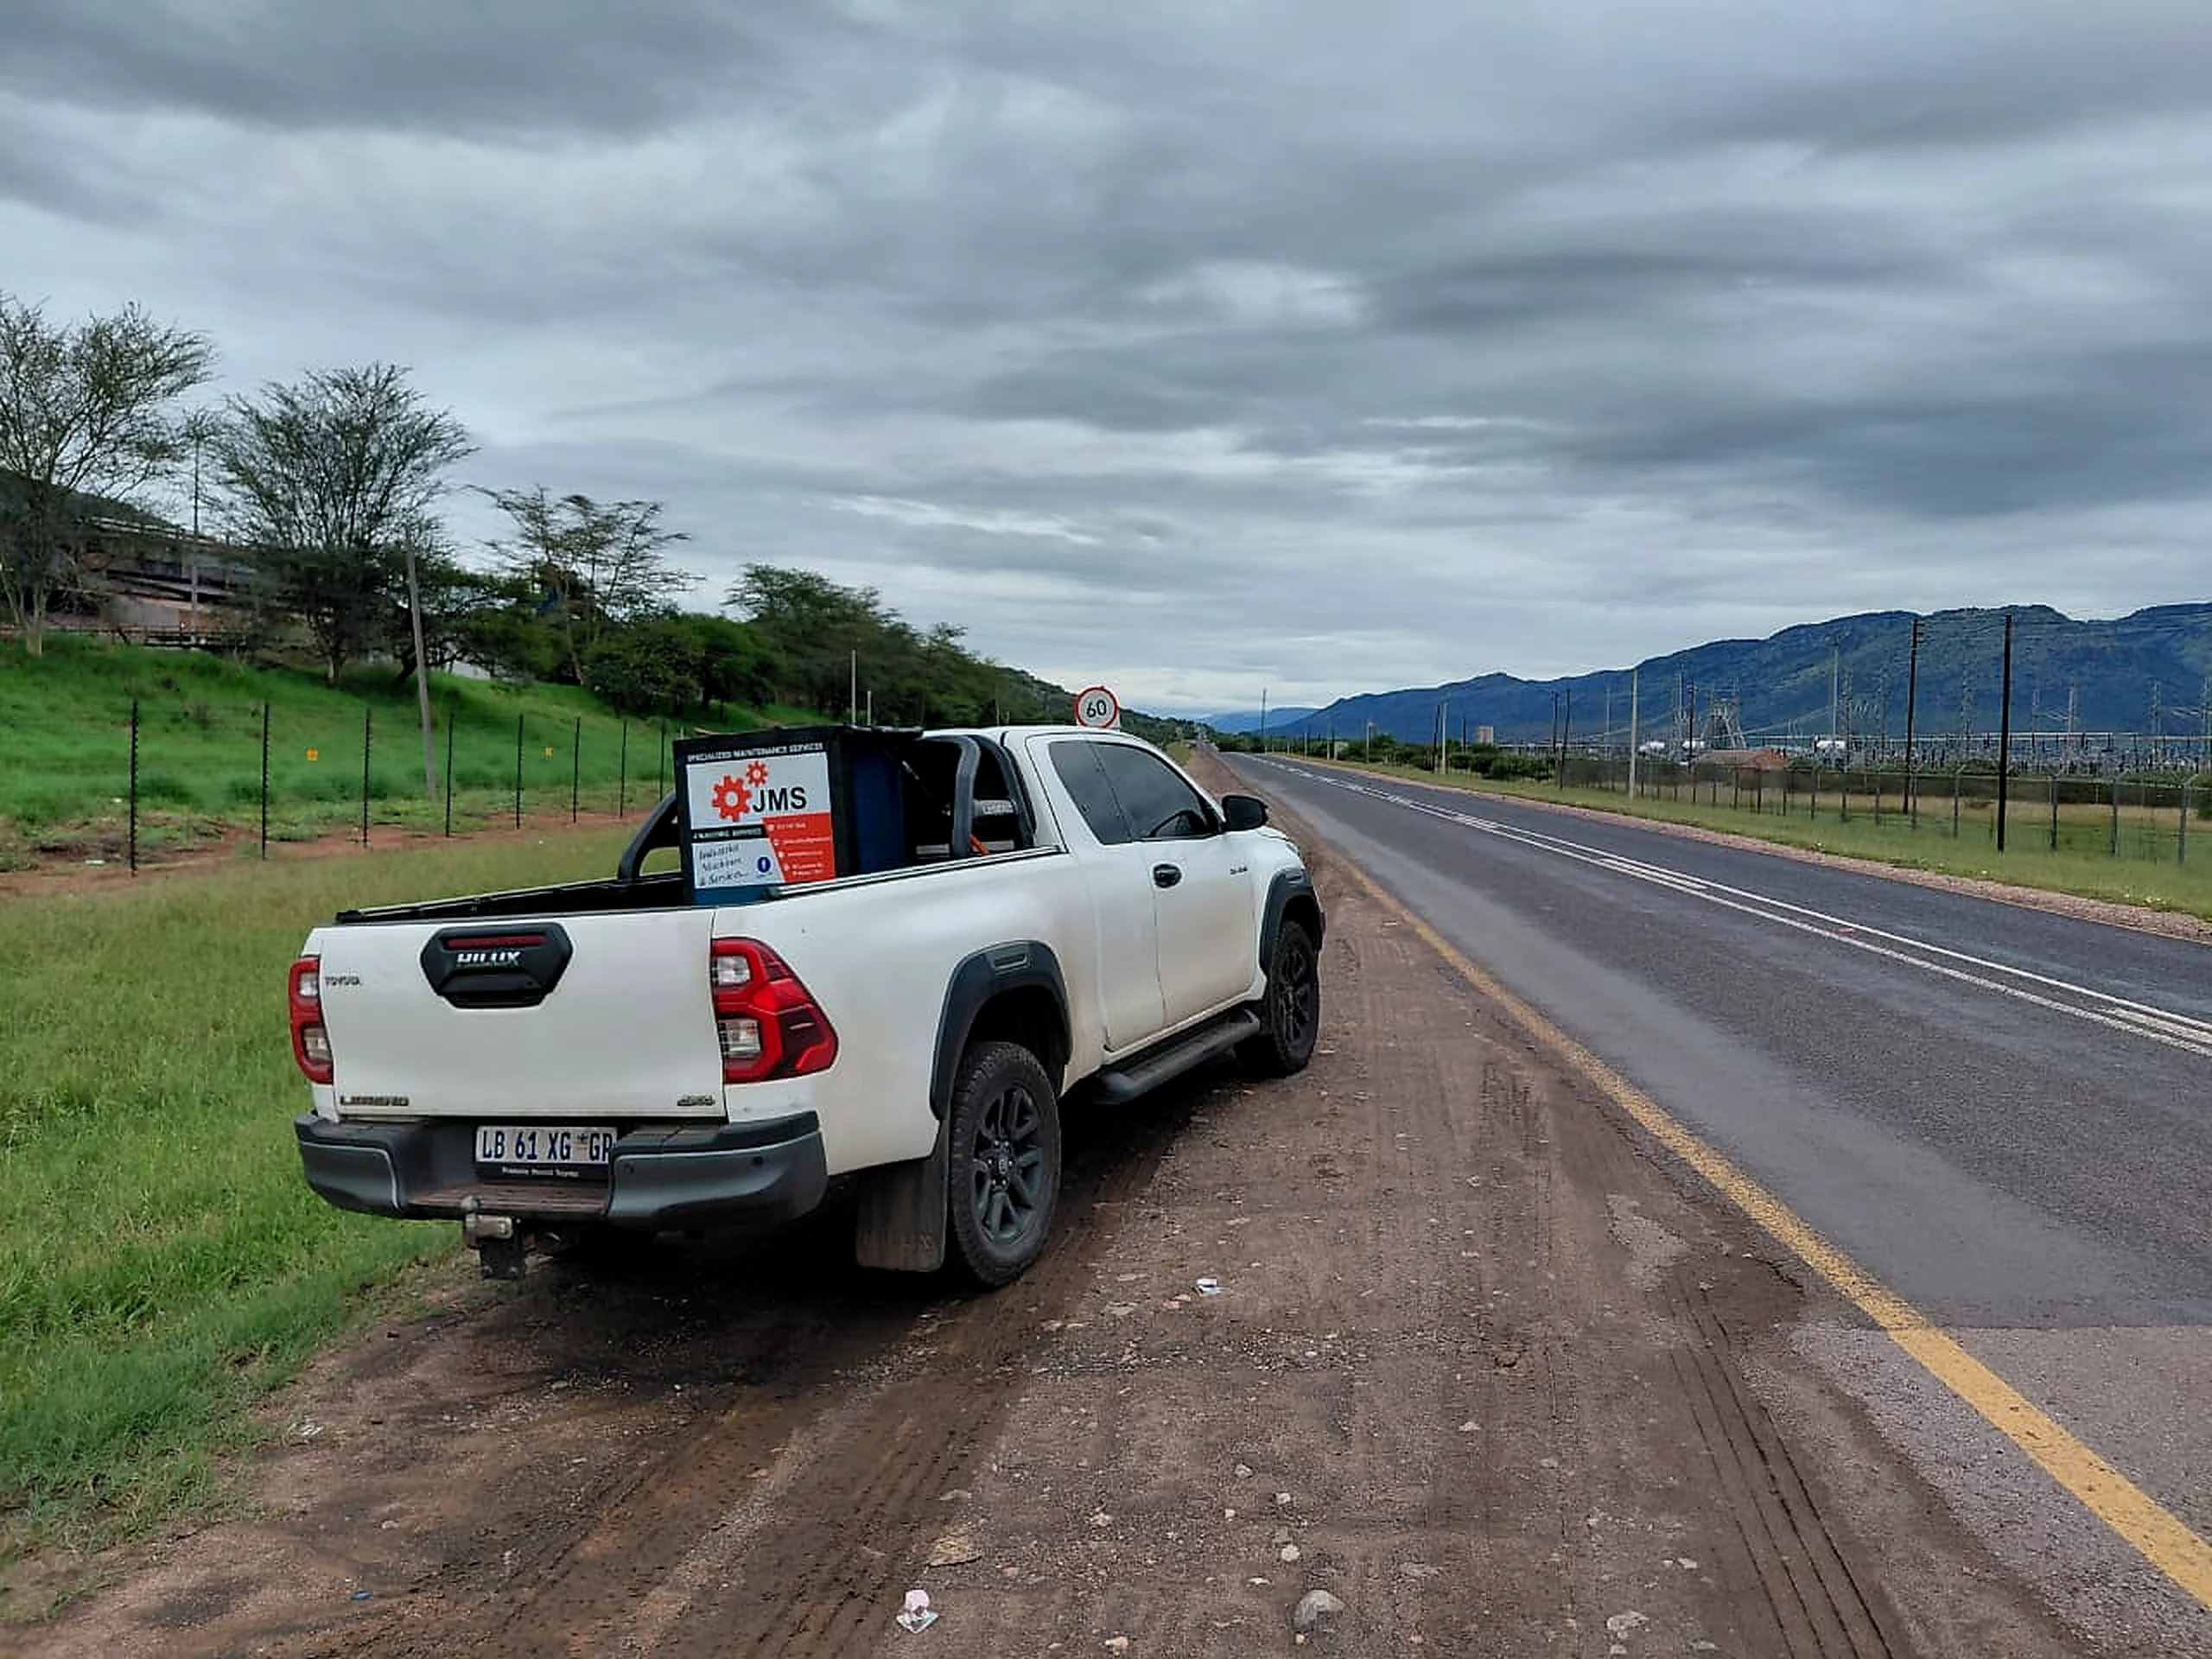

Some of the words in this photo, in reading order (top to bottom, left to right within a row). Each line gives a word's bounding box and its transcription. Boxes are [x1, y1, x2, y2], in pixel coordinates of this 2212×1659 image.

[1086, 699, 1107, 718] 60
[753, 786, 807, 812] JMS
[456, 951, 522, 968] HILUX
[325, 976, 361, 987] TOYOTA
[482, 1130, 505, 1159] LB
[515, 1131, 537, 1160] 61
[547, 1132, 571, 1160] XG
[589, 1133, 613, 1162] GP
